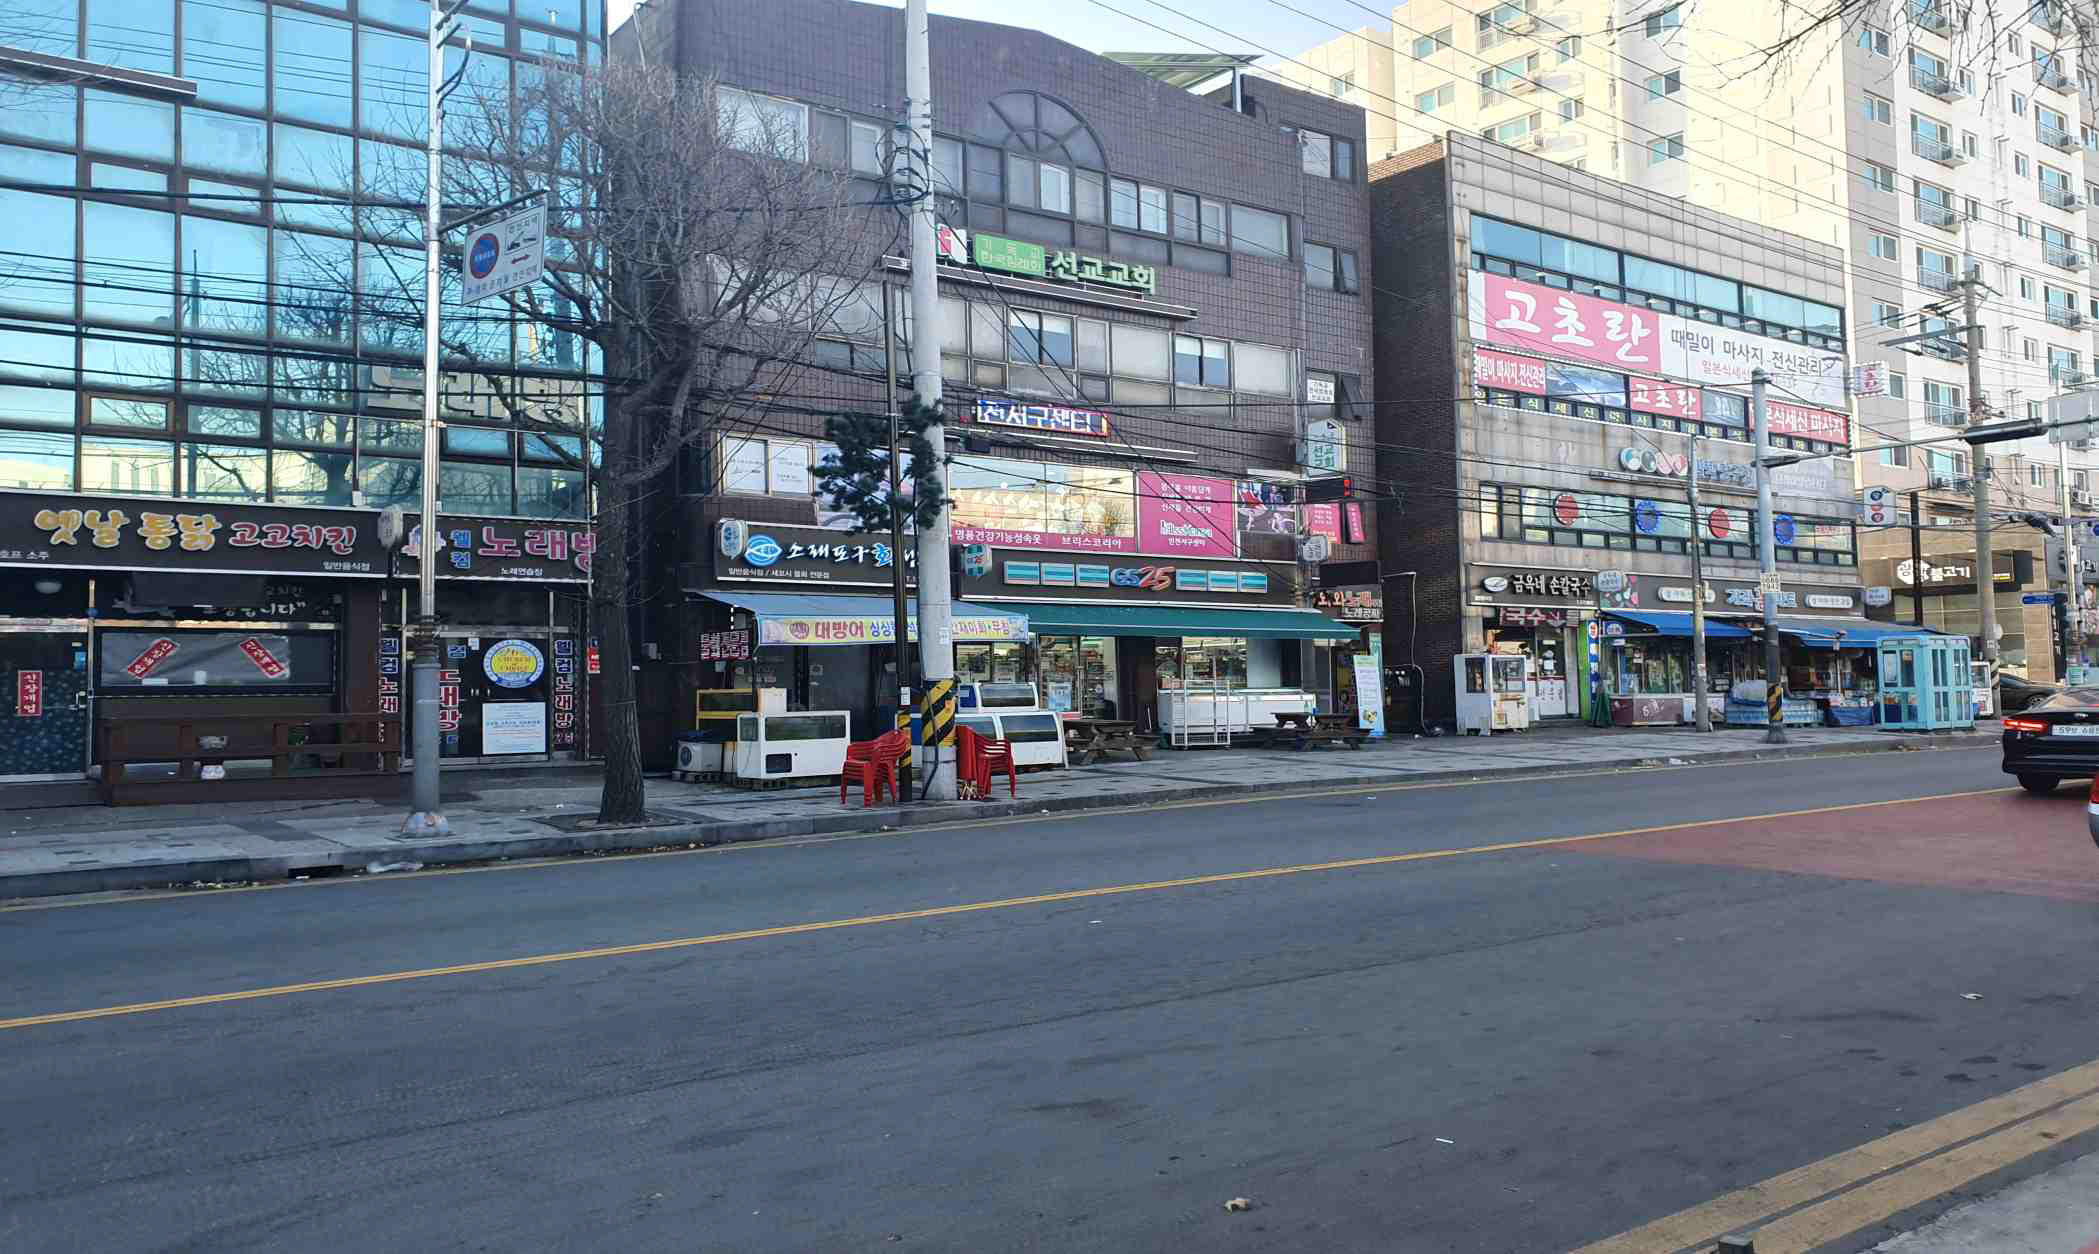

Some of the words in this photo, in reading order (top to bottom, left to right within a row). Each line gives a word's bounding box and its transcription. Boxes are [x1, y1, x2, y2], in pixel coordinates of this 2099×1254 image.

[1052, 250, 1156, 295] 선교교회
[1495, 289, 1652, 364] 고초란
[1671, 327, 1715, 353] 때밀이
[1771, 351, 1823, 377] 전신관리
[1634, 383, 1697, 416] 고초란
[34, 509, 130, 548] 옛날
[137, 512, 222, 551] 통닭
[229, 522, 357, 556] 고고치킨
[1062, 535, 1121, 549] 브리스코리아
[1110, 566, 1176, 590] GS25
[1513, 573, 1546, 595] 금옥네
[1550, 574, 1592, 597] 손칼국수
[1931, 563, 1971, 582] 불고기
[815, 620, 865, 639] 대방어
